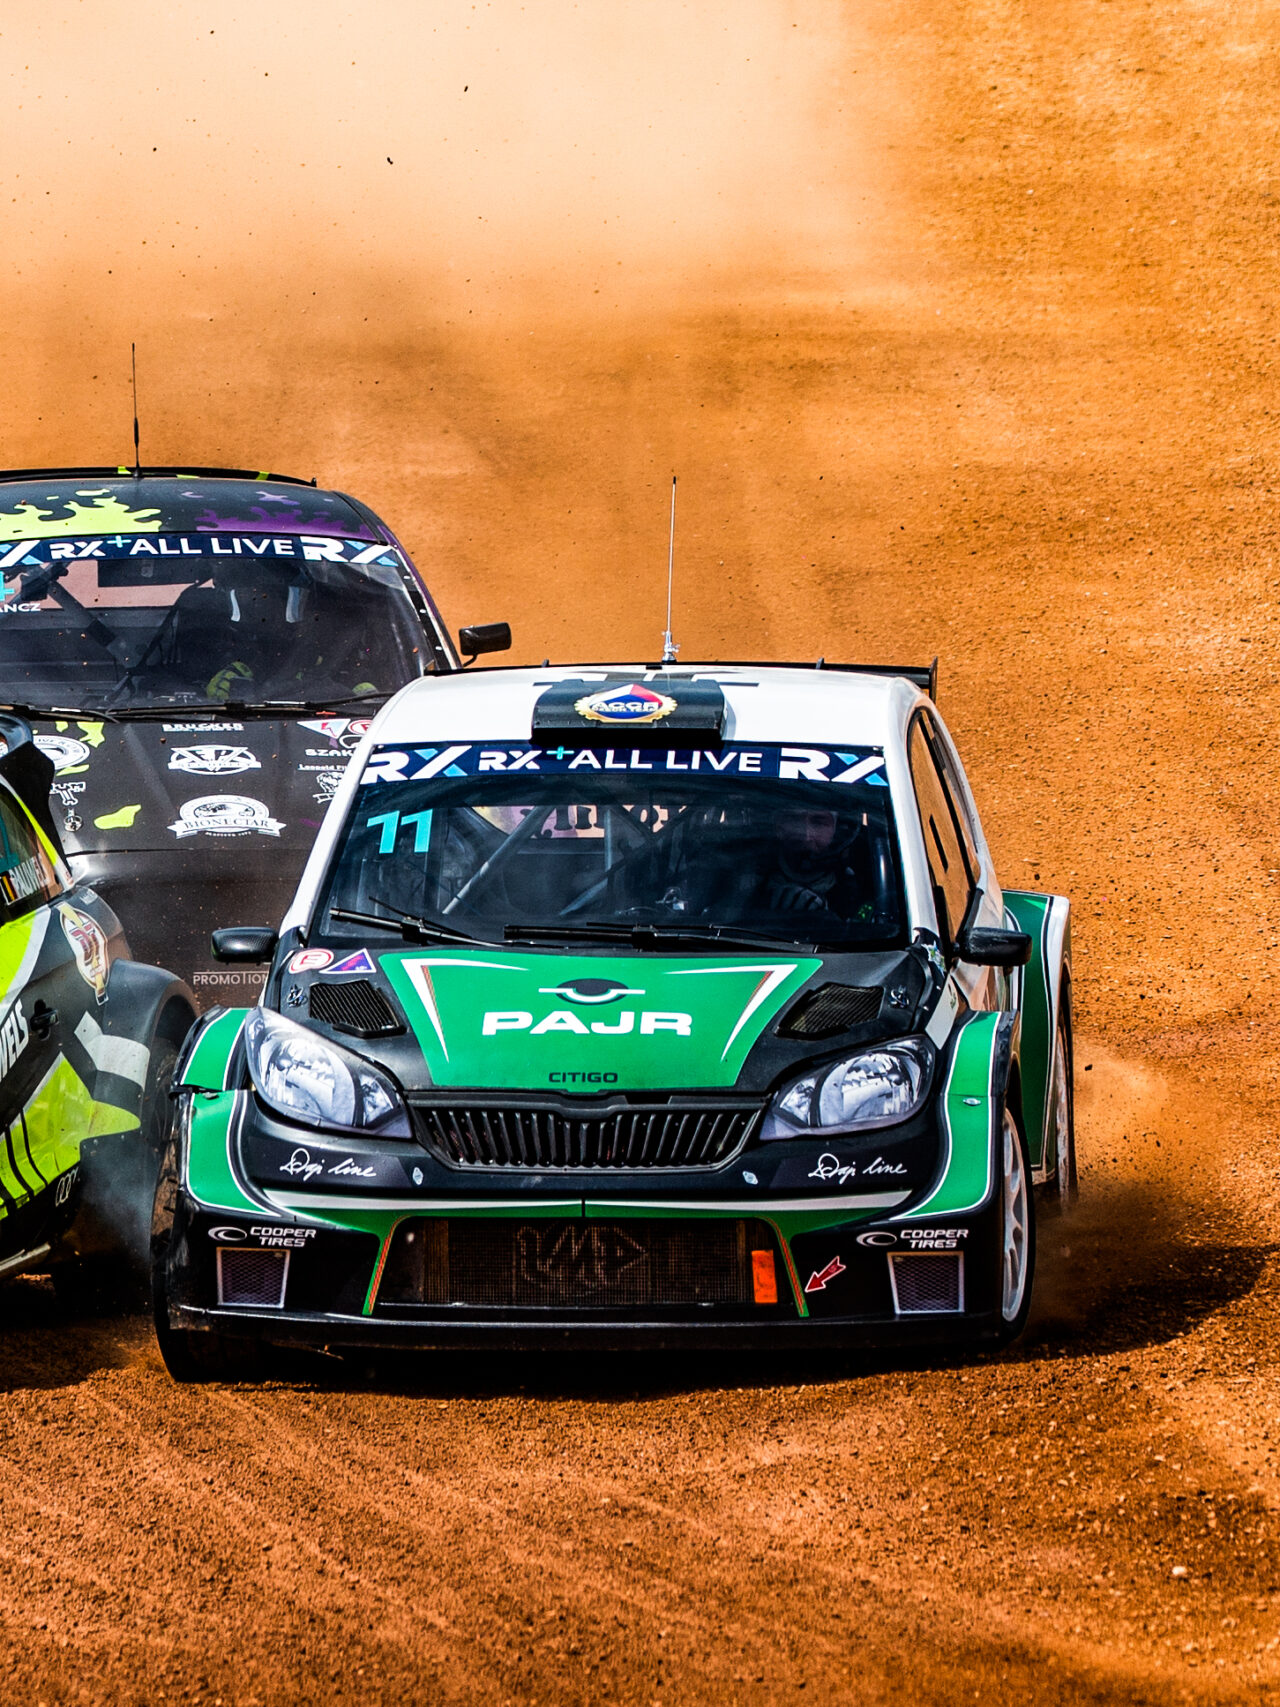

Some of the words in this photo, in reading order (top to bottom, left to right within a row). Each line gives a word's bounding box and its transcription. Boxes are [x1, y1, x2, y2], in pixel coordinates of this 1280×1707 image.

[212, 537, 293, 556] LIVE
[300, 536, 399, 567] RX
[360, 745, 472, 784] RX
[666, 751, 762, 772] LIVE
[779, 748, 888, 786] RX
[367, 809, 432, 855] 11
[482, 1010, 692, 1036] PAJR
[548, 1072, 618, 1083] CITIGO
[250, 1226, 317, 1239] COOPER
[259, 1236, 306, 1247] TIRES
[900, 1229, 969, 1239] COOPER
[909, 1239, 958, 1248] TIRES
